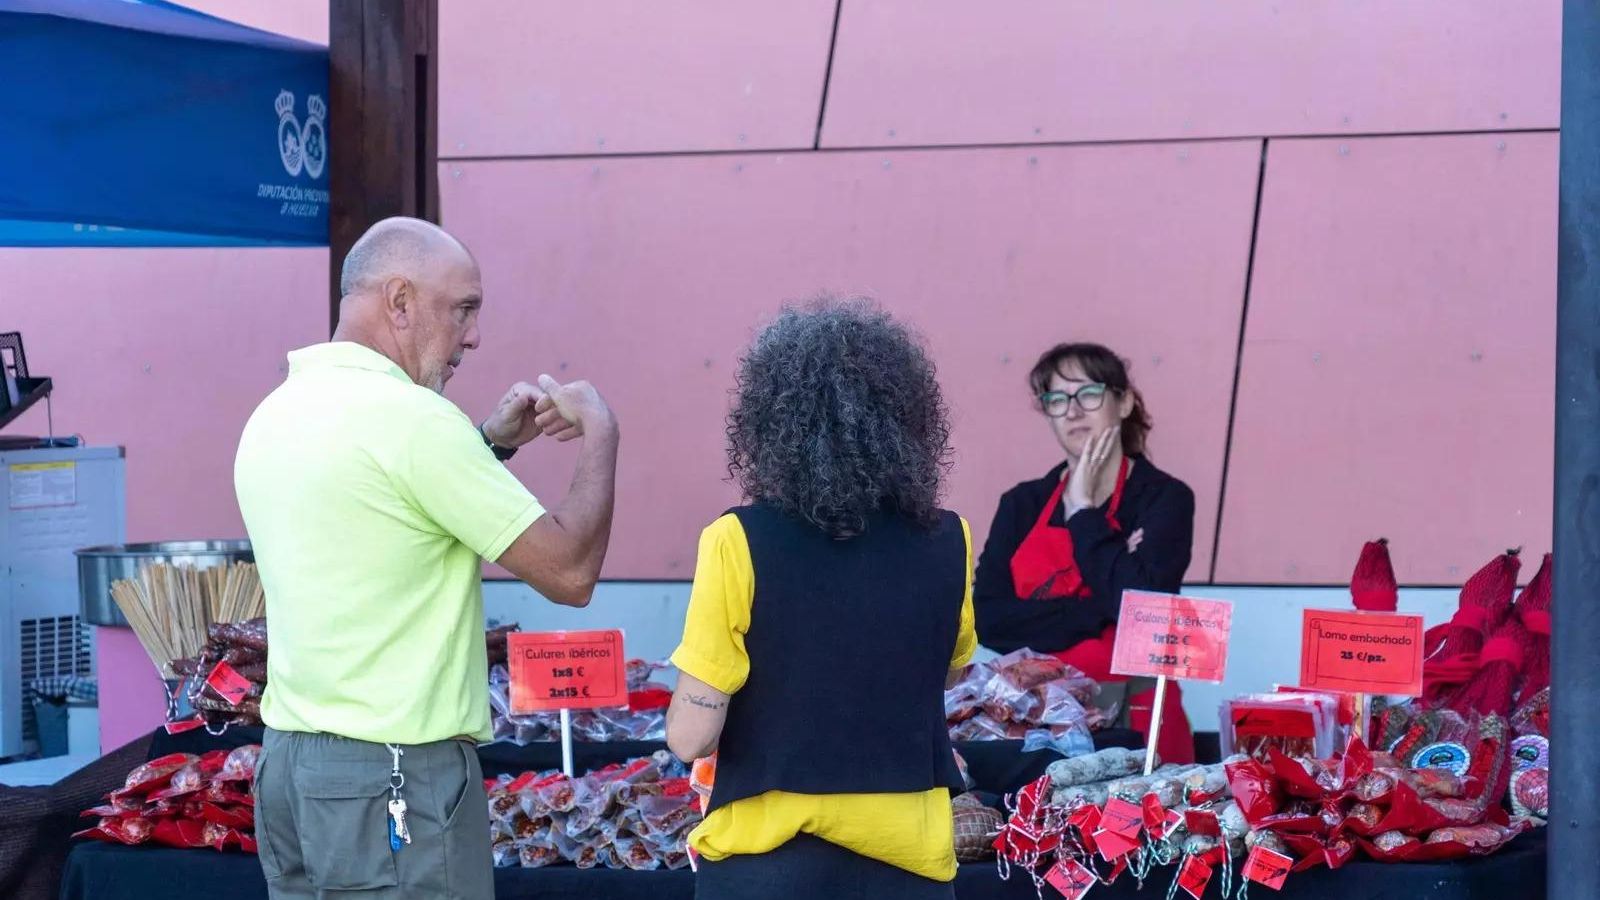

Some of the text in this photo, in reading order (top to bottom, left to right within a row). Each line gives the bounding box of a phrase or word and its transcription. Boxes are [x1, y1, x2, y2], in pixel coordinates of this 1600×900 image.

[1319, 629, 1412, 646] Lomo embuchado
[525, 646, 611, 660] Culares ibéricos
[1340, 650, 1354, 660] 25
[552, 666, 585, 678] 1x8 €
[549, 685, 591, 698] 2x15 €
